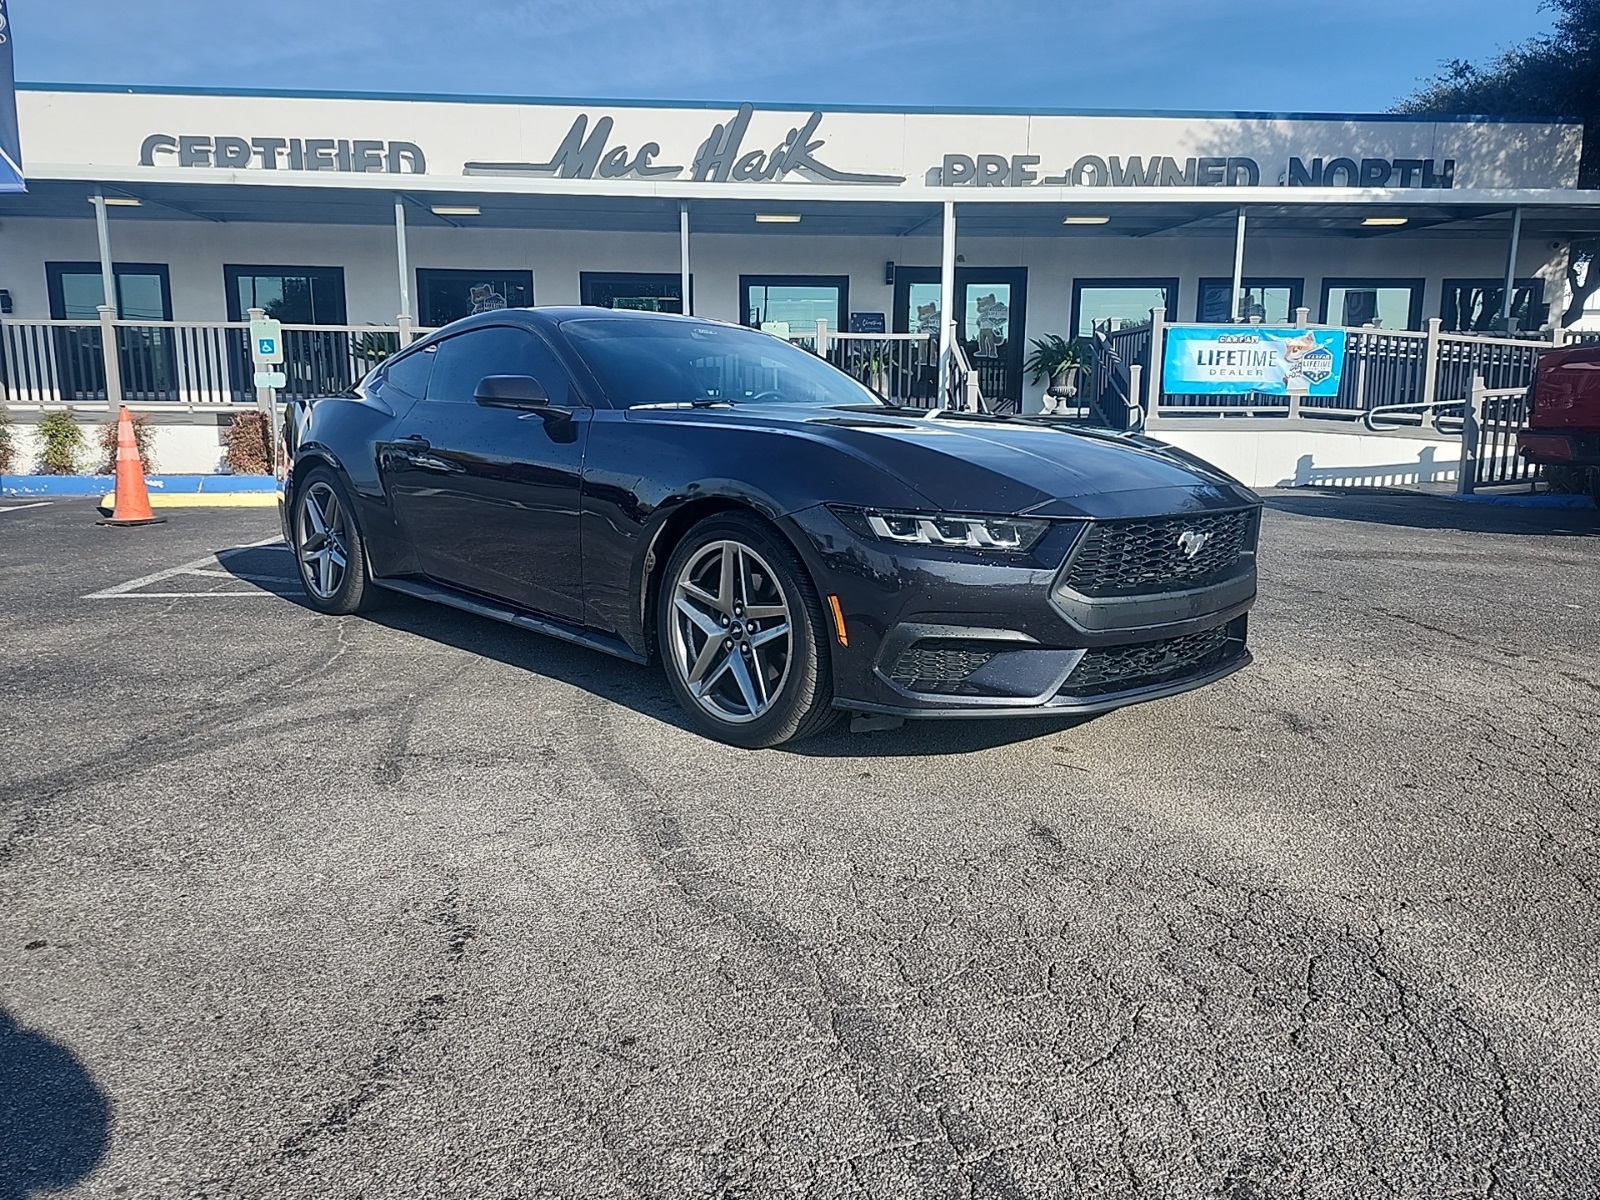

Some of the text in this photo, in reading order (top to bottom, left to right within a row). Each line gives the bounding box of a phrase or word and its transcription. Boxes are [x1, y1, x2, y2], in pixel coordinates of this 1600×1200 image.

[464, 102, 907, 185] Mac Haik
[139, 133, 427, 175] CERTIFIED
[942, 153, 1456, 189] PRE-OWNED NORTH
[1217, 335, 1260, 345] CARFAX
[1197, 349, 1278, 367] LIFETIME
[1302, 360, 1331, 368] LIFETIME
[1209, 368, 1264, 376] DEALER
